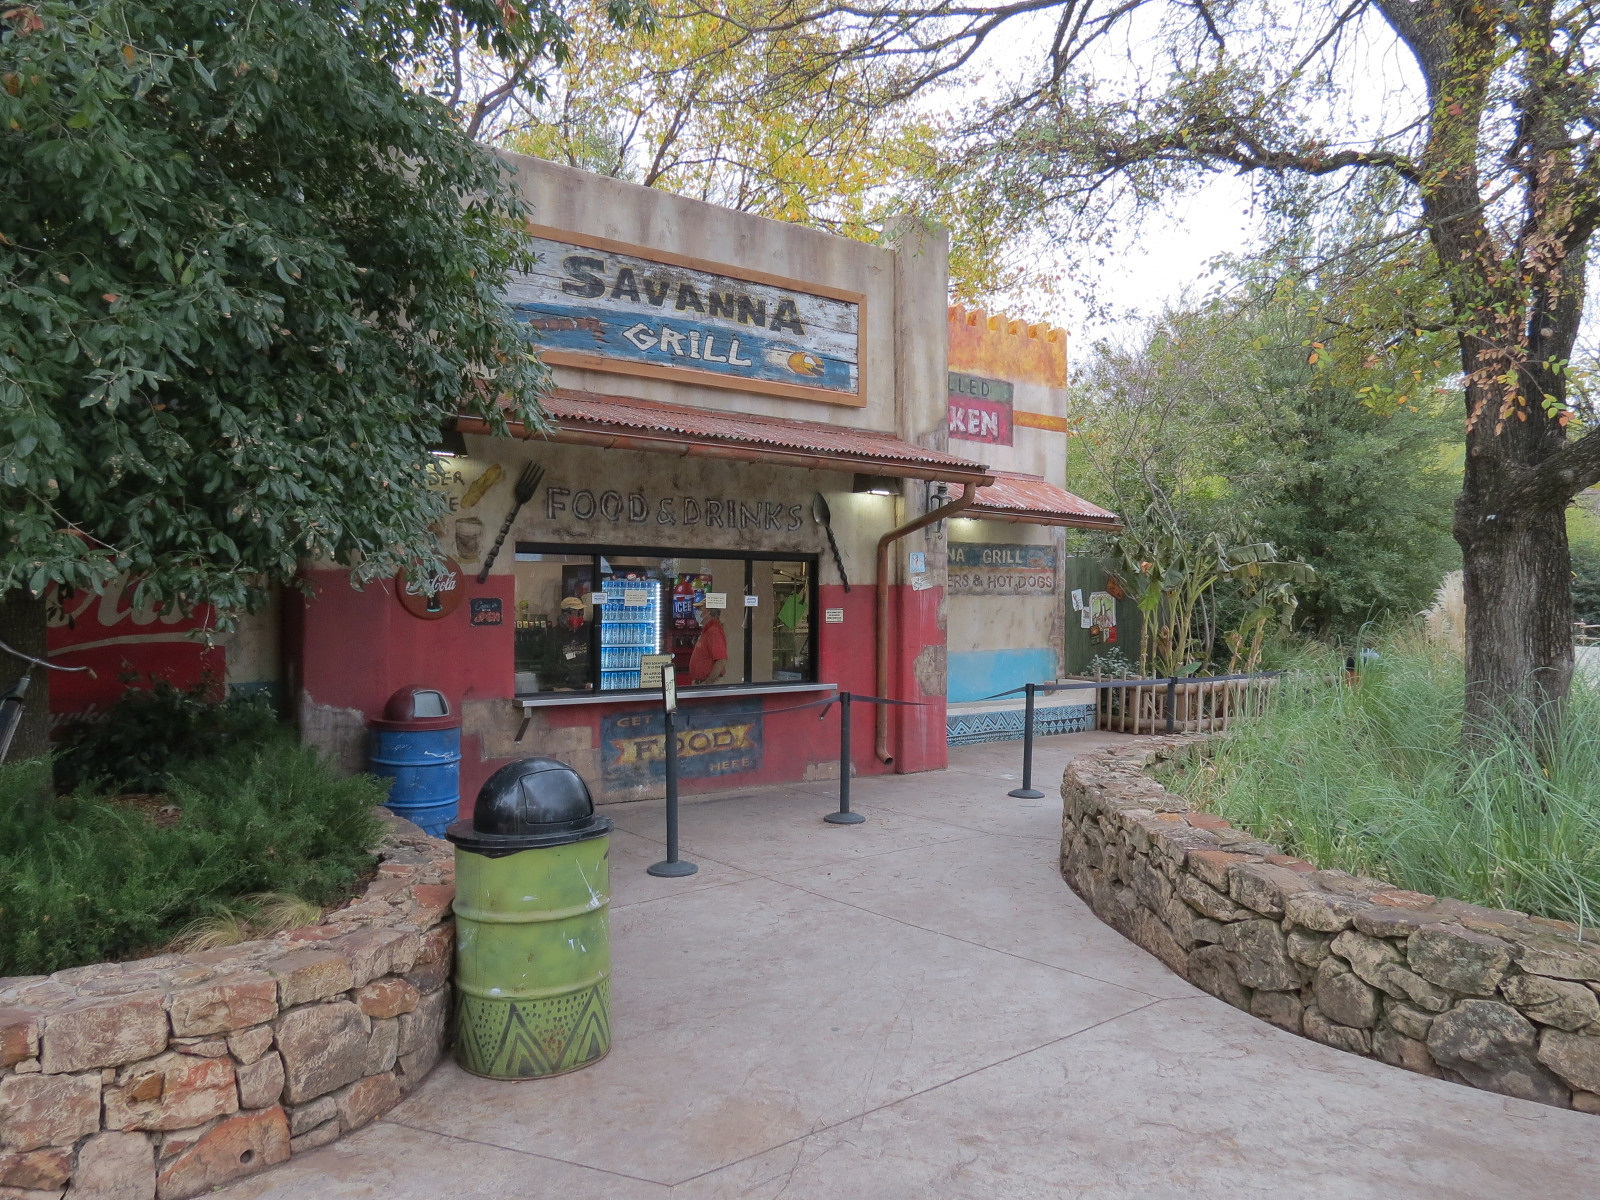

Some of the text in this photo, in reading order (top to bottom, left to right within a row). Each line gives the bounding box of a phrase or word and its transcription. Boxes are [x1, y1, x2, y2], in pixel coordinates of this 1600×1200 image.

[560, 253, 806, 336] SAVANNA
[622, 322, 752, 366] GRILL
[949, 406, 999, 438] KEN
[546, 486, 804, 532] FOOD & DRINKS
[982, 549, 1023, 564] GRILL
[988, 575, 1013, 589] HOT
[1015, 575, 1053, 589] DOGS
[674, 601, 692, 613] ICEE
[617, 715, 652, 728] GET
